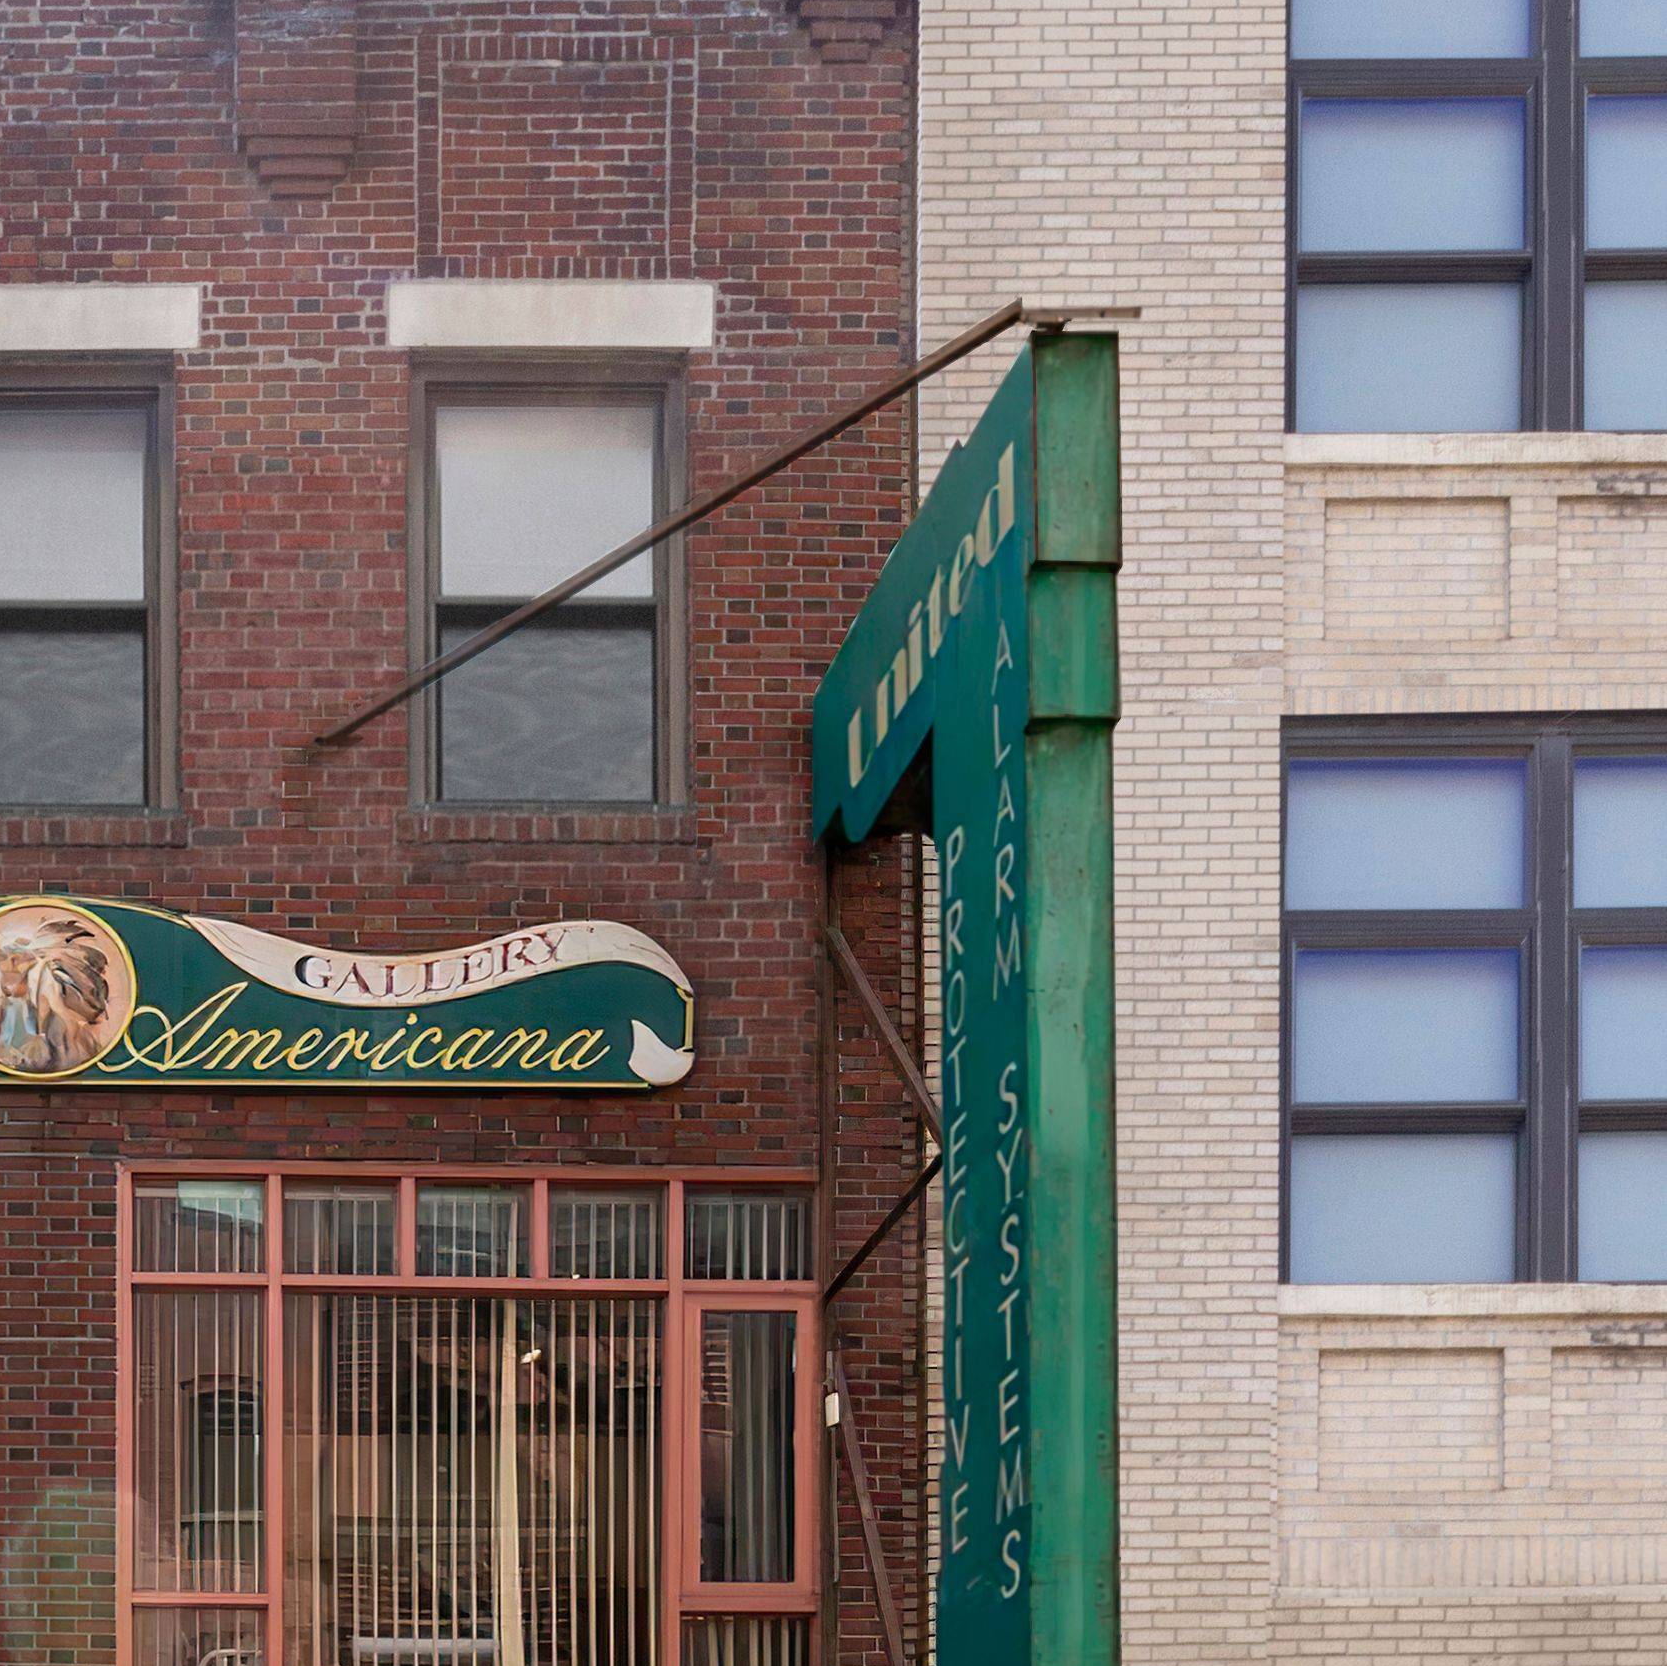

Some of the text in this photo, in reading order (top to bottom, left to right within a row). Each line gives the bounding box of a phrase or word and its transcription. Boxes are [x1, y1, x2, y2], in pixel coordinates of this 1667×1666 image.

[96, 981, 611, 1074] Americana
[293, 930, 569, 999] GALLERY
[991, 618, 1024, 1600] ALARM SYSTEMS
[944, 824, 970, 1554] PROTECTIVE
